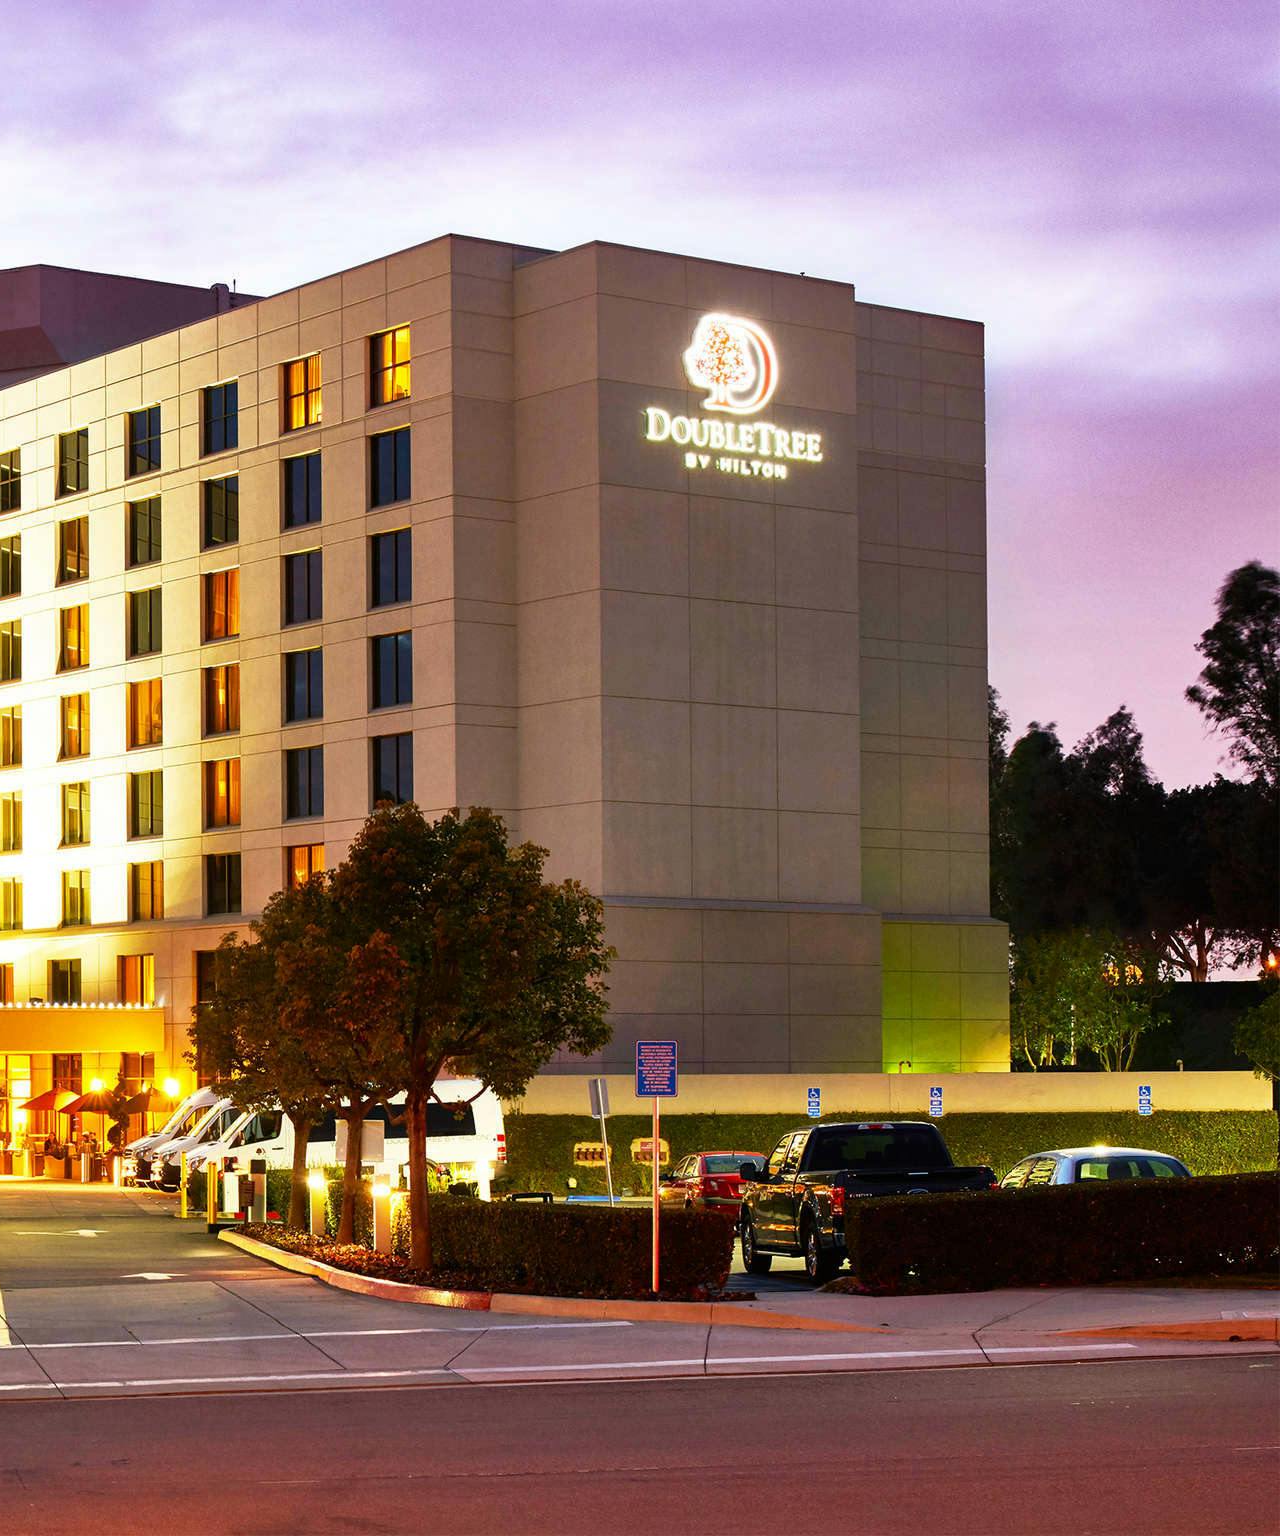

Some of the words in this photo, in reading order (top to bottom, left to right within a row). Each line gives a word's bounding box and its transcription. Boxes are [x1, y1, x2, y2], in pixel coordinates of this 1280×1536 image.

[645, 407, 824, 462] DOUBLETREE
[685, 453, 710, 469] BY
[718, 457, 788, 480] HILTON
